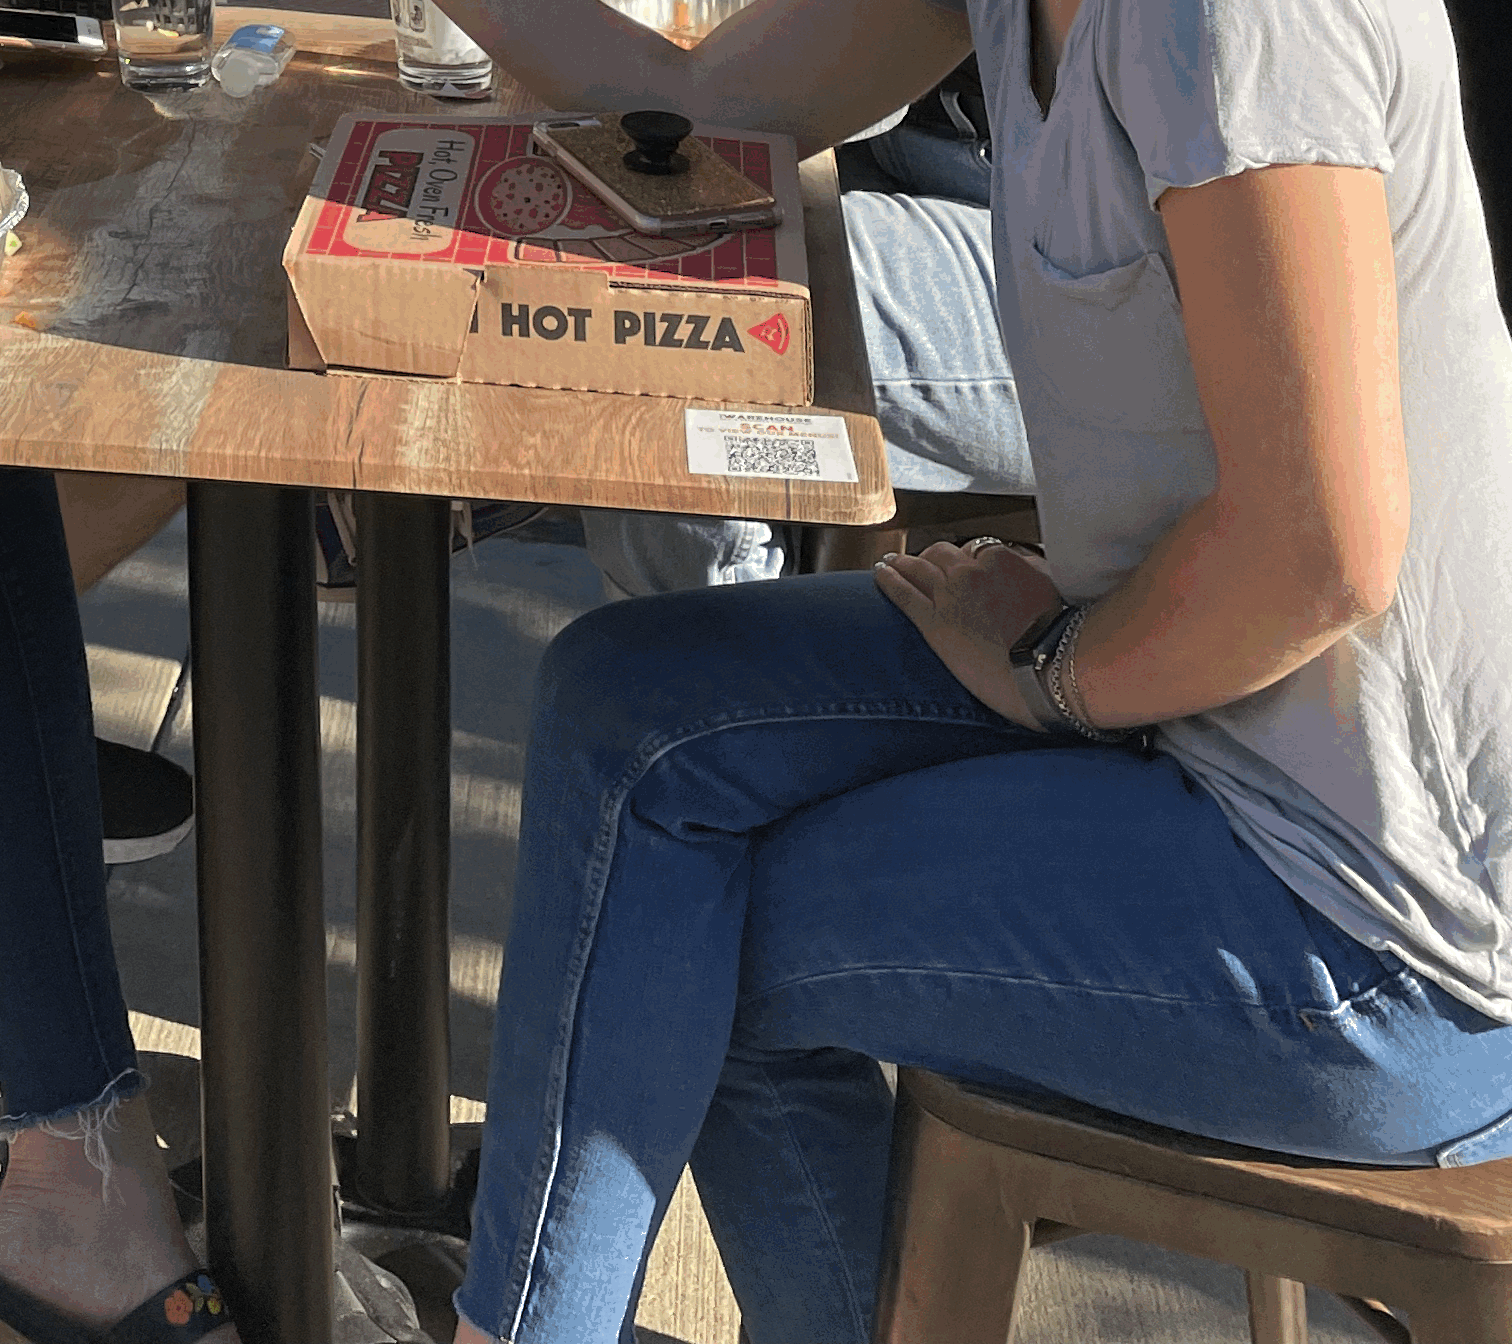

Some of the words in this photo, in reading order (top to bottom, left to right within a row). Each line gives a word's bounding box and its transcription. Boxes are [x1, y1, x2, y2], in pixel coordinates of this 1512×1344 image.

[422, 168, 458, 203] Oven
[409, 205, 449, 242] Fresh
[501, 302, 592, 343] HOT
[614, 310, 746, 354] PIZZA
[740, 423, 794, 432] SCAN
